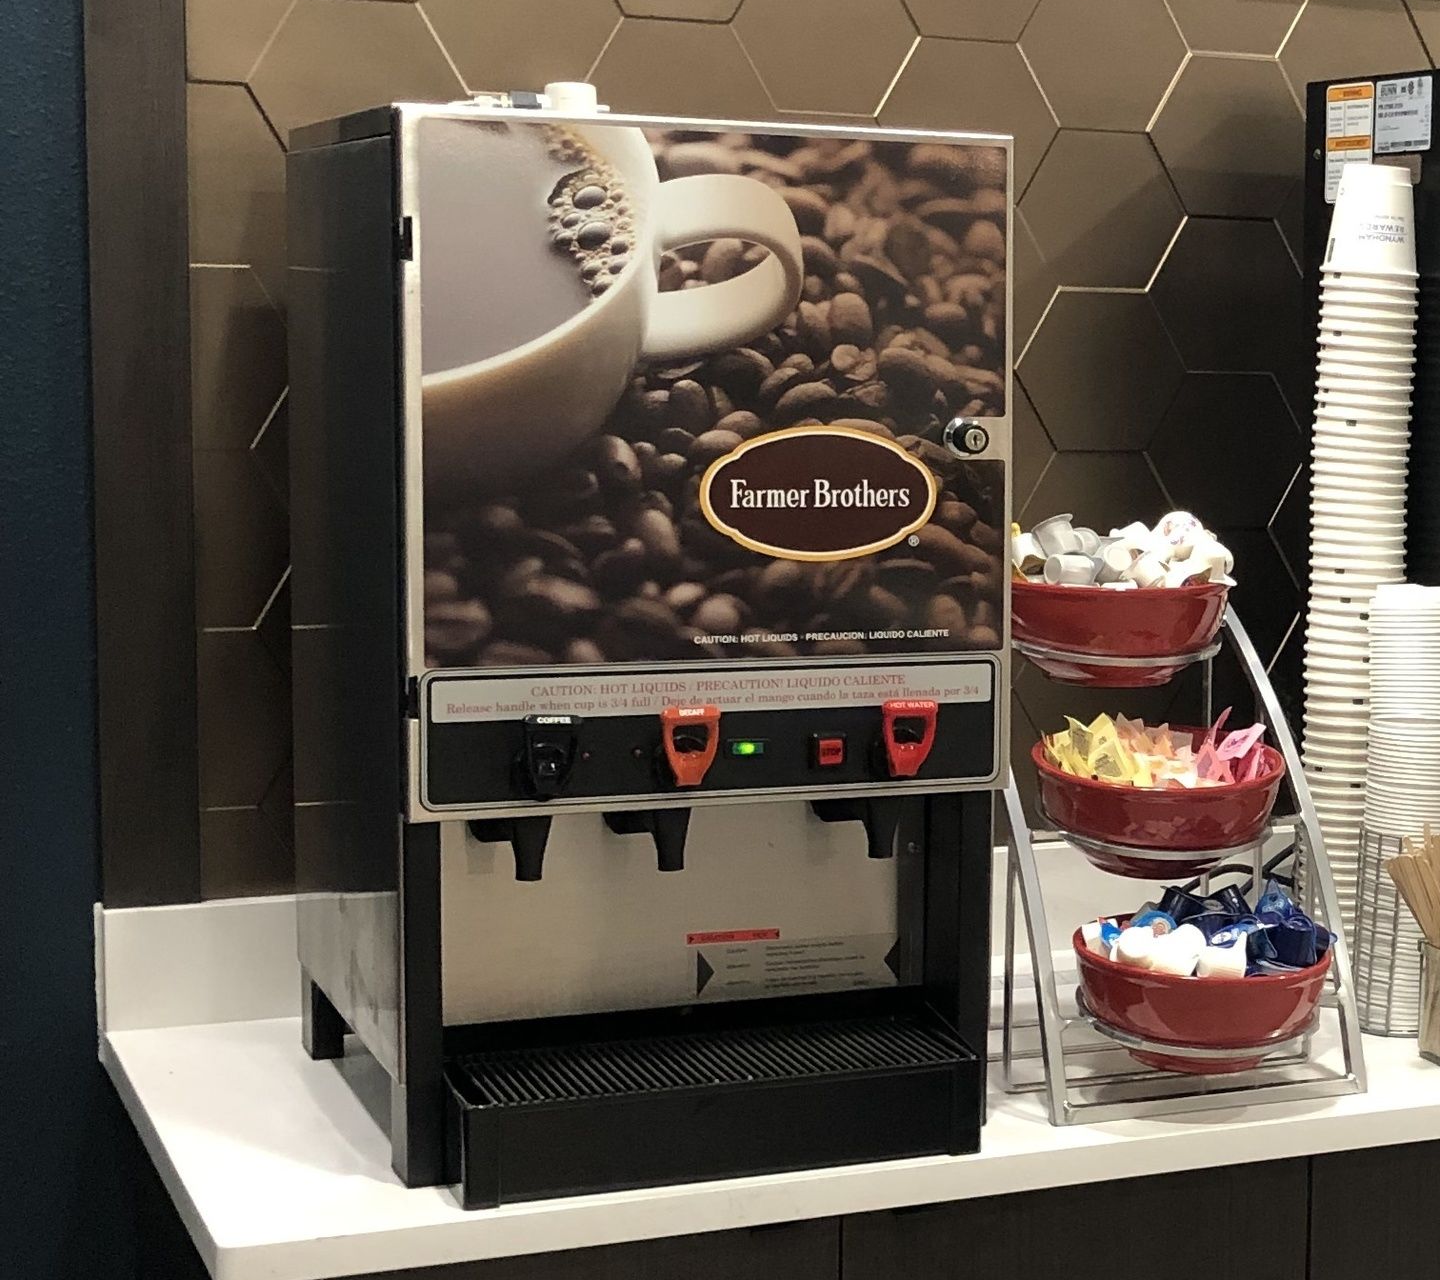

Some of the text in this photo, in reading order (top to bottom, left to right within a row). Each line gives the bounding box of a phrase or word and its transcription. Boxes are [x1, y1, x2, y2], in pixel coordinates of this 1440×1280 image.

[730, 478, 910, 509] Farmer Brothers
[694, 635, 739, 645] CAUTION:
[741, 634, 760, 644] HOT
[762, 633, 799, 643] LIQUIDS
[868, 630, 905, 640] LIQUIDO
[906, 629, 950, 639] CALIENTE
[530, 684, 598, 698] CAUTION:
[600, 683, 628, 695] HOT
[631, 681, 687, 695] LIQUIDS
[787, 676, 841, 689] LIQUIDO
[843, 674, 906, 688] CALIENTE
[446, 703, 493, 715] Release
[496, 701, 536, 713] handle
[539, 700, 572, 711] when
[574, 701, 595, 712] cup
[599, 699, 608, 709] is
[611, 697, 628, 709] 3/4
[631, 696, 651, 708] full
[689, 695, 702, 706] de
[706, 695, 741, 706] actuar
[745, 693, 755, 704] el
[758, 694, 795, 705] mango
[797, 690, 837, 702] cuando
[839, 689, 849, 700] la
[852, 690, 874, 700] taza
[902, 686, 941, 698] llenada
[944, 687, 961, 698] por
[963, 685, 979, 696] 3/4
[890, 701, 935, 710] HOT WATER
[536, 716, 572, 725] COFFEE
[821, 747, 842, 757] STOP
